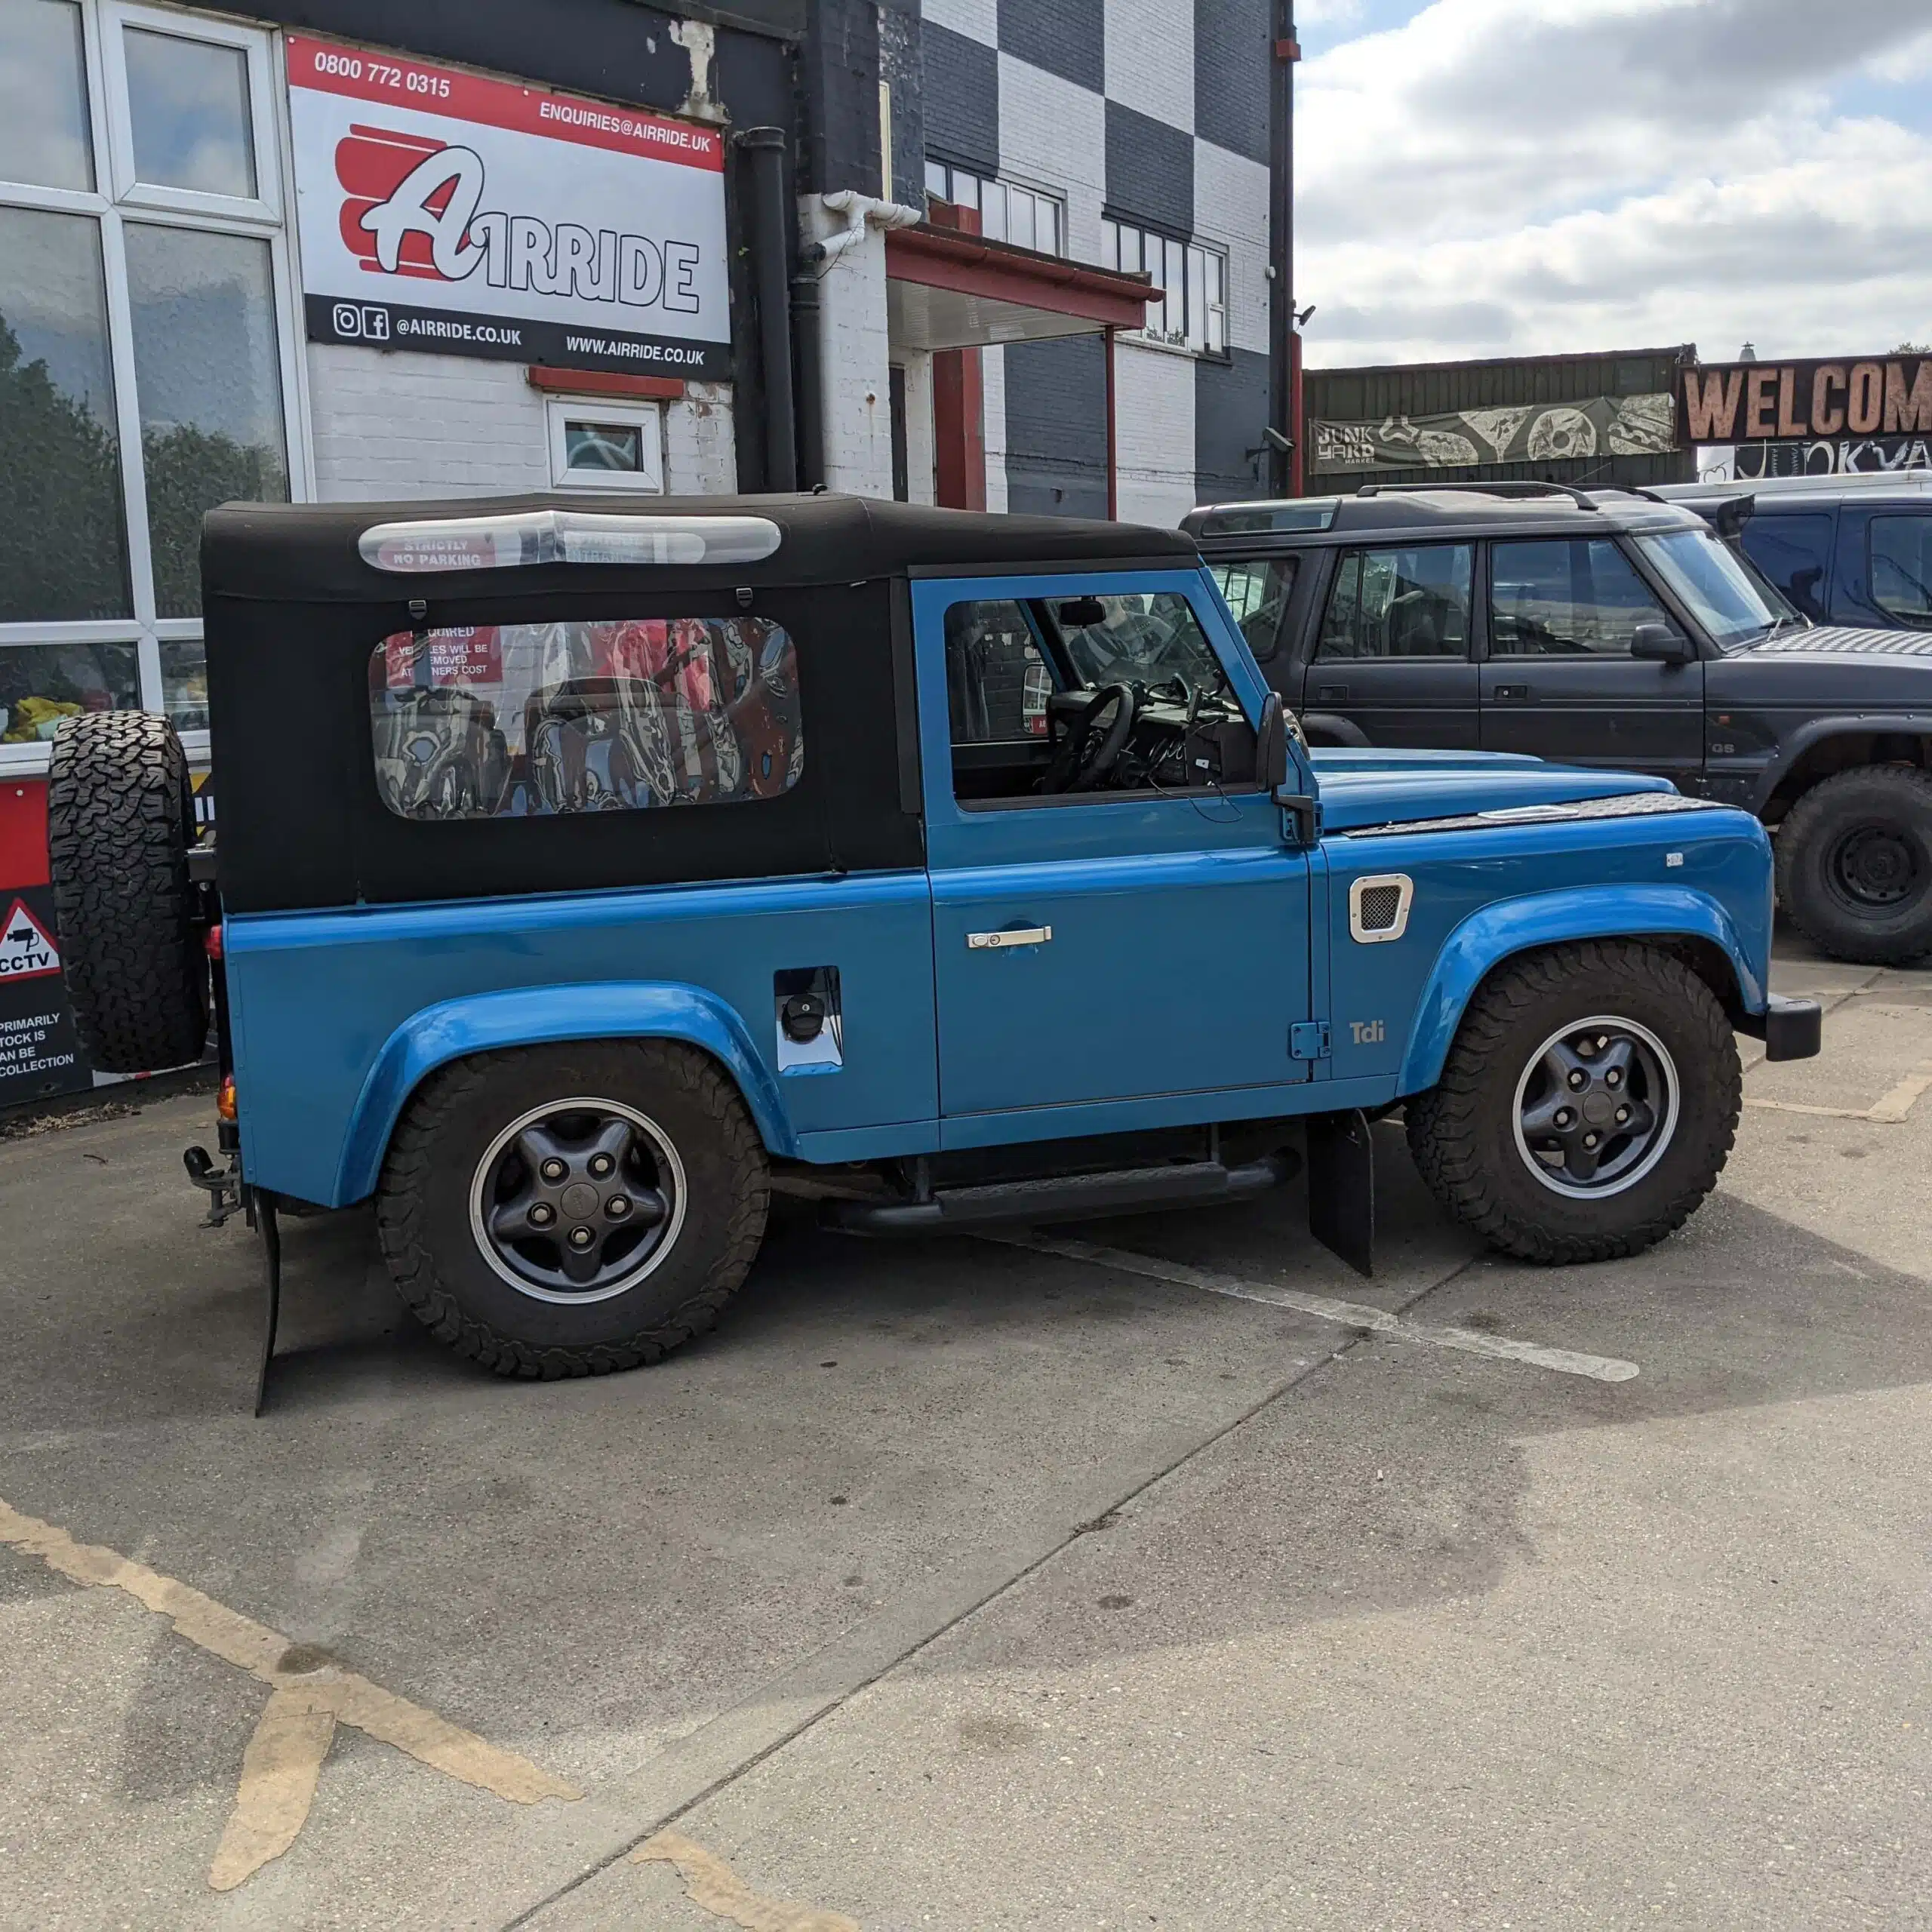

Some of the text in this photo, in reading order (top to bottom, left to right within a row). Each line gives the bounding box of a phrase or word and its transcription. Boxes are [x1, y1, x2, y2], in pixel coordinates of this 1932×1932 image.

[315, 52, 450, 97] 0800 772 0315
[540, 102, 710, 152] ENQUIRIES@AIRRIDE.UK
[359, 145, 700, 314] AIRRIDE
[397, 318, 521, 346] @AIRRIDE.CO.UK
[567, 336, 705, 365] WWW.AIRRIDE.CO.UK
[1684, 361, 1932, 438] WELCOM
[1318, 426, 1374, 444] JUNK
[1318, 444, 1374, 460] YARD
[405, 540, 468, 551] STRICTLY
[394, 554, 481, 565] NO PARKING
[450, 645, 471, 654] WILL
[430, 655, 467, 664] EMOVED
[401, 665, 488, 676] AT NERS COST
[0, 952, 50, 972] CCTV
[0, 1030, 45, 1048] TOCK IS
[1349, 1020, 1384, 1044] Tdi
[0, 1046, 35, 1062] AN BE
[0, 1054, 74, 1077] COLLECTION
